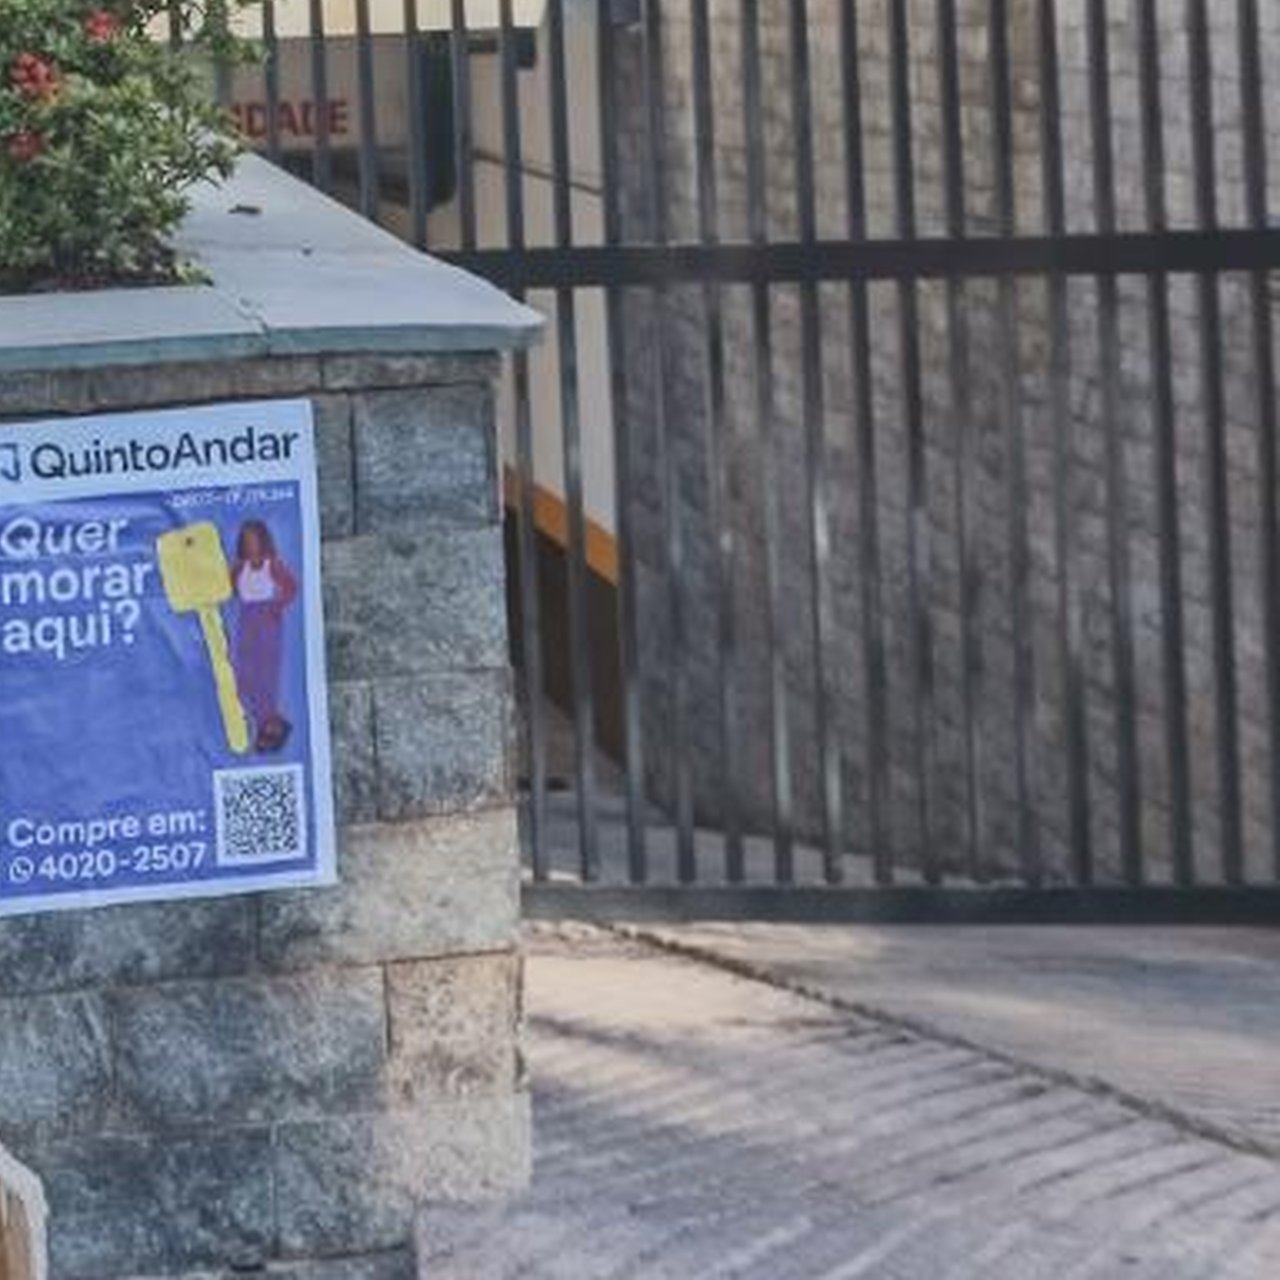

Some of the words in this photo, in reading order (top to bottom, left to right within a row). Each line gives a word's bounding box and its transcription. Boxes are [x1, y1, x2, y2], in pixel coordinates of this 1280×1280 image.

[28, 426, 300, 479] QuintoAndar
[0, 561, 153, 605] morar
[2, 599, 141, 660] aqui?
[7, 814, 141, 848] Compre
[148, 809, 207, 836] em:
[40, 841, 207, 881] 4020-2507
